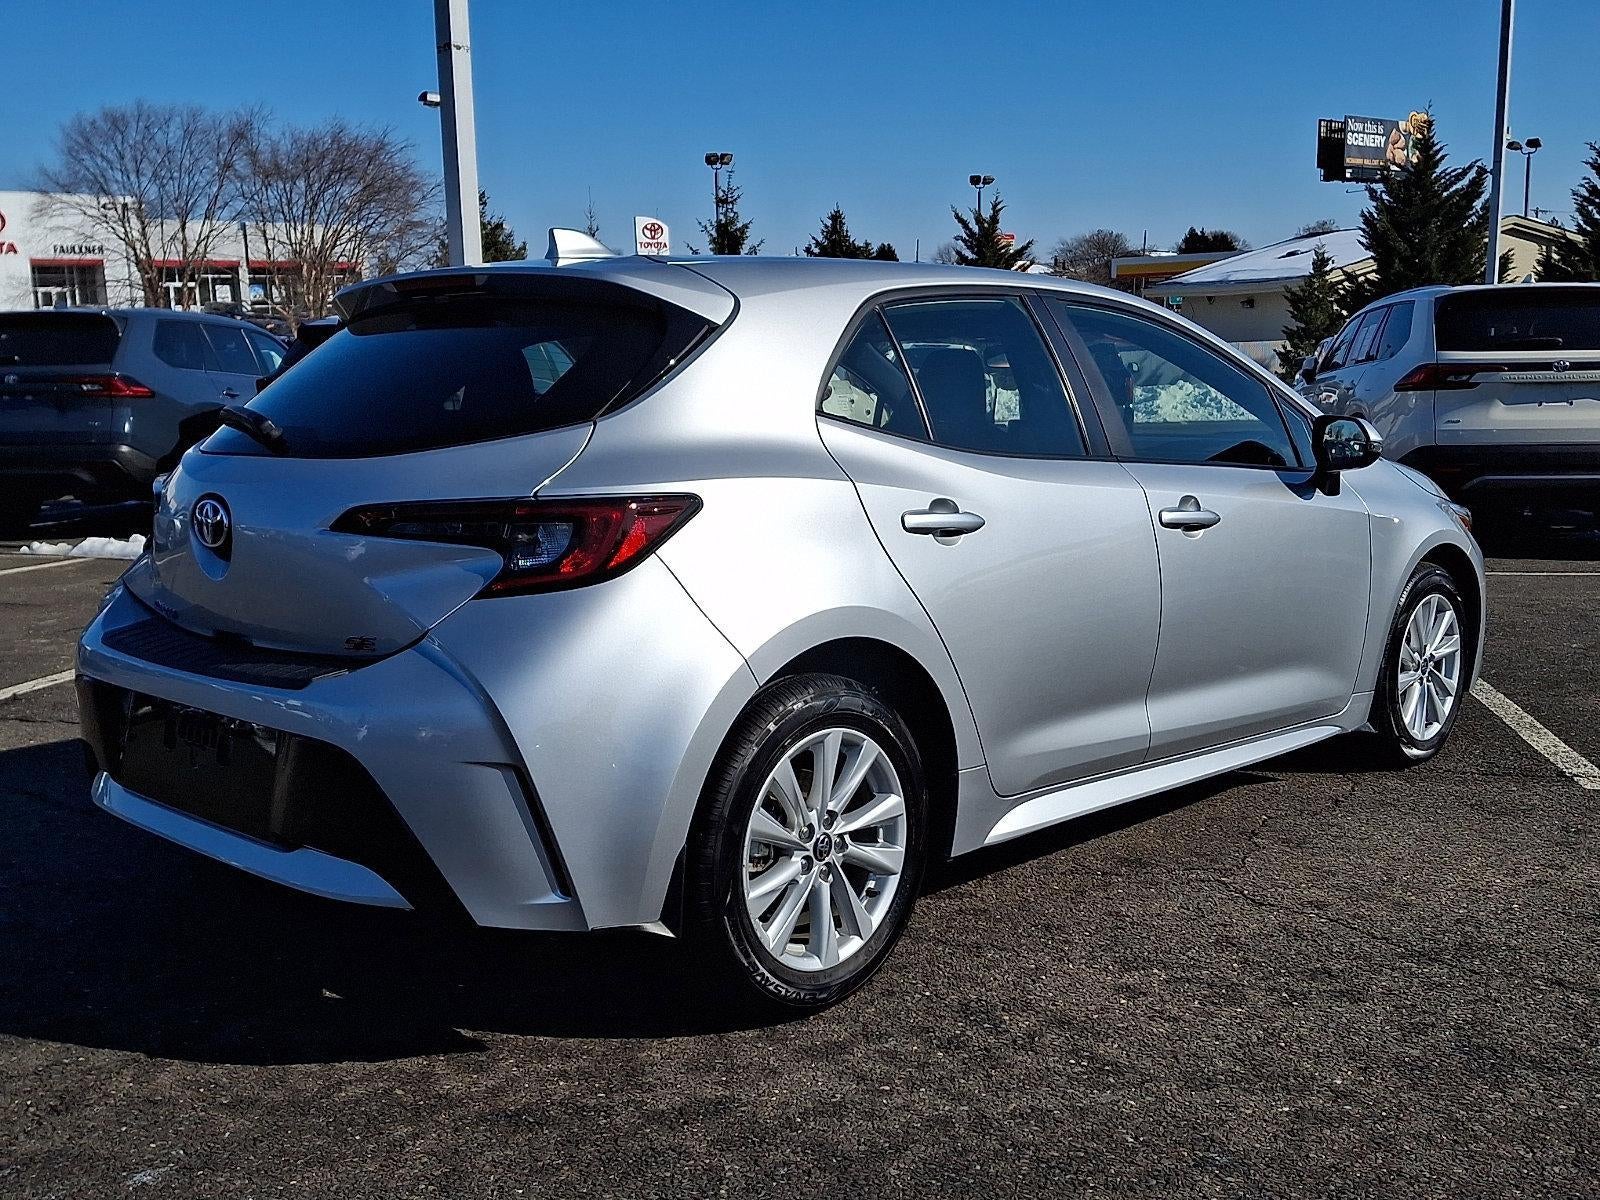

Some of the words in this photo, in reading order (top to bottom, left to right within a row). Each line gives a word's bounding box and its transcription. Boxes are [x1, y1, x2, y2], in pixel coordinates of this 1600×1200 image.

[1347, 118, 1364, 131] Now
[1364, 121, 1377, 133] this
[1377, 122, 1384, 134] is
[1346, 131, 1386, 148] SCENERY
[53, 244, 104, 255] FAULKNER
[639, 241, 668, 249] TOYOTA
